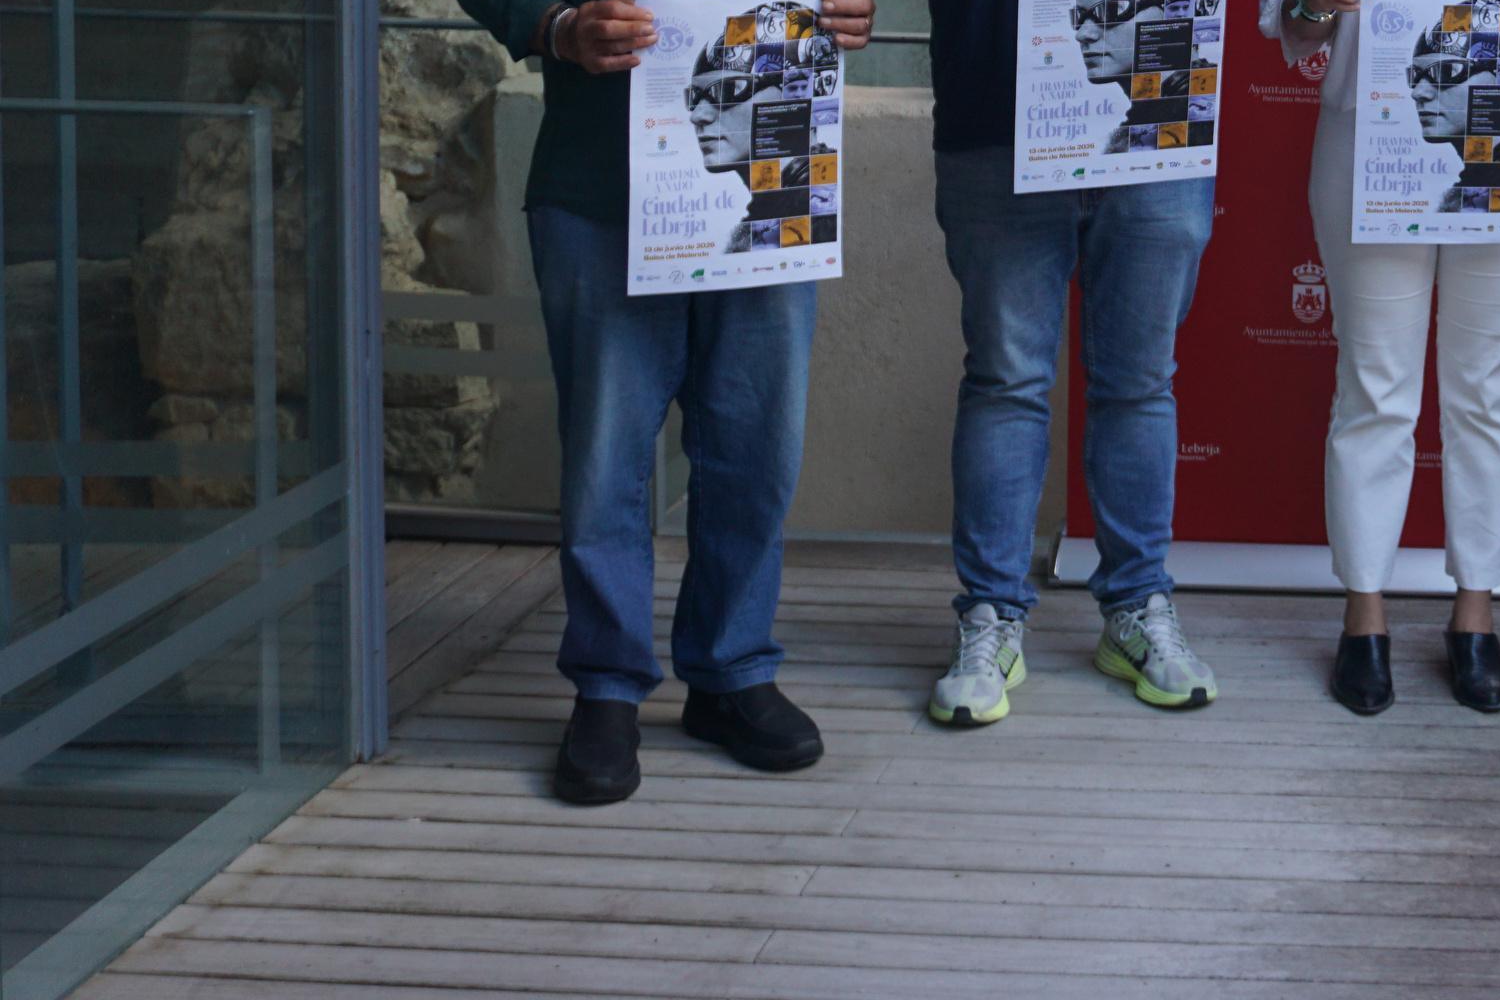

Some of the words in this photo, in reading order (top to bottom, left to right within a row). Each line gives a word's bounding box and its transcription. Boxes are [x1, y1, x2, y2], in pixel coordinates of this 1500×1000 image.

[1027, 100, 1089, 121] Ciudad
[1096, 98, 1115, 115] de
[1027, 118, 1087, 141] Lebrija
[1365, 157, 1424, 174] Ciudad
[1430, 158, 1448, 175] de
[1365, 175, 1422, 196] Lebrija
[642, 192, 707, 215] Ciudad
[715, 190, 735, 209] de
[642, 214, 706, 238] Lebrija
[1181, 442, 1221, 457] Lebrija
